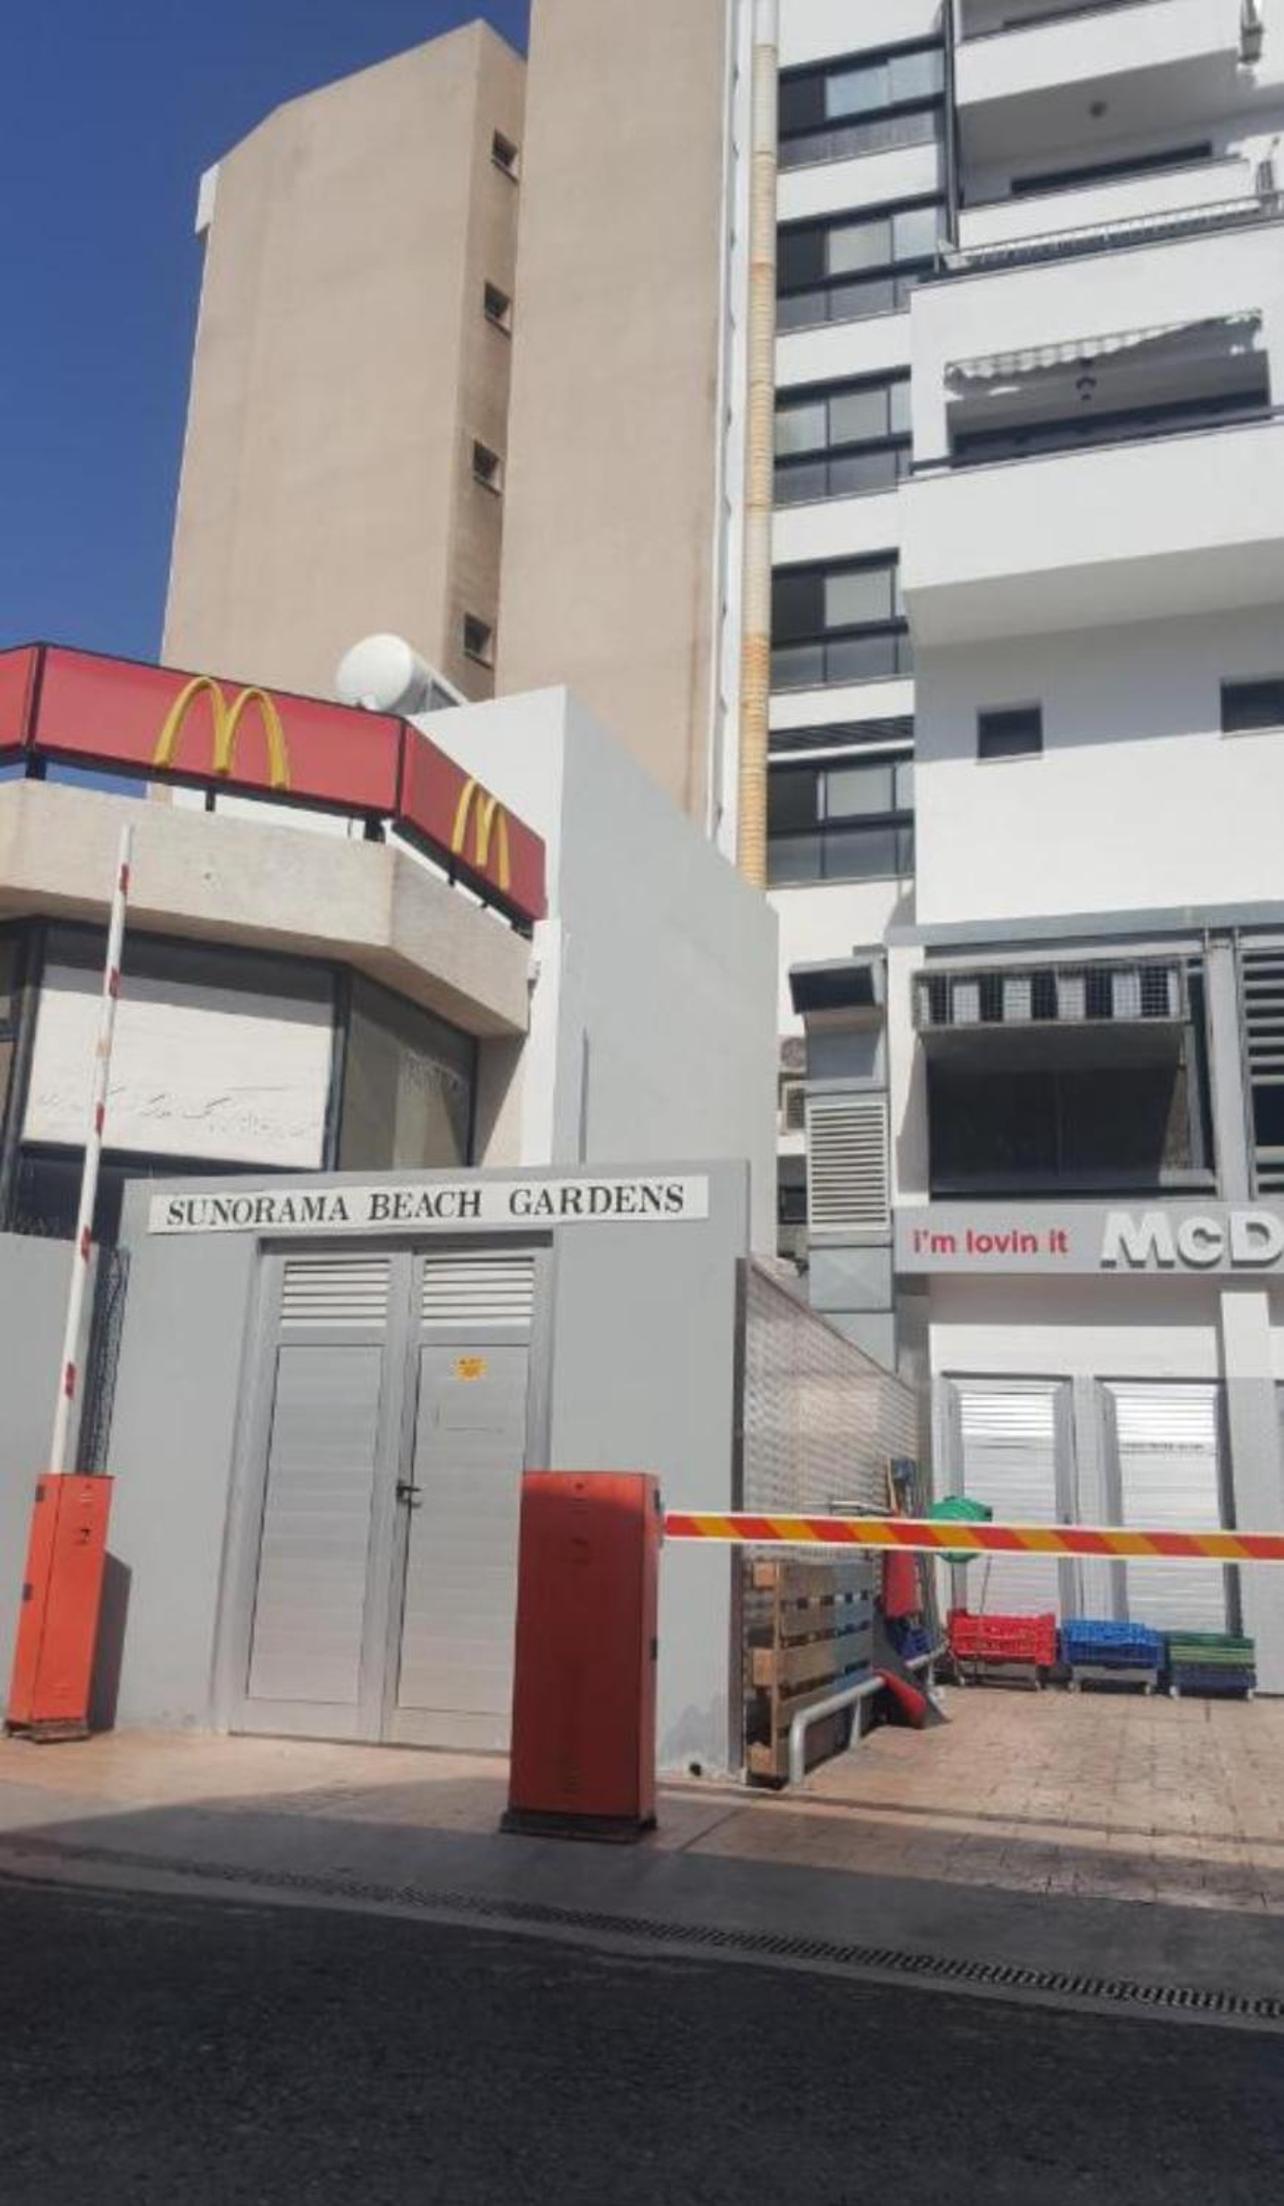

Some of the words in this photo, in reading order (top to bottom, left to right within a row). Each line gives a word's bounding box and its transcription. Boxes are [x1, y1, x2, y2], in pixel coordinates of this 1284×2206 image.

[166, 1195, 349, 1226] SUNORAMA
[369, 1189, 482, 1220] BEACH
[509, 1184, 684, 1216] GARDENS
[914, 1229, 956, 1253] i'm
[966, 1229, 1038, 1253] lovin
[1049, 1229, 1068, 1253] it
[1101, 1211, 1283, 1269] McD
